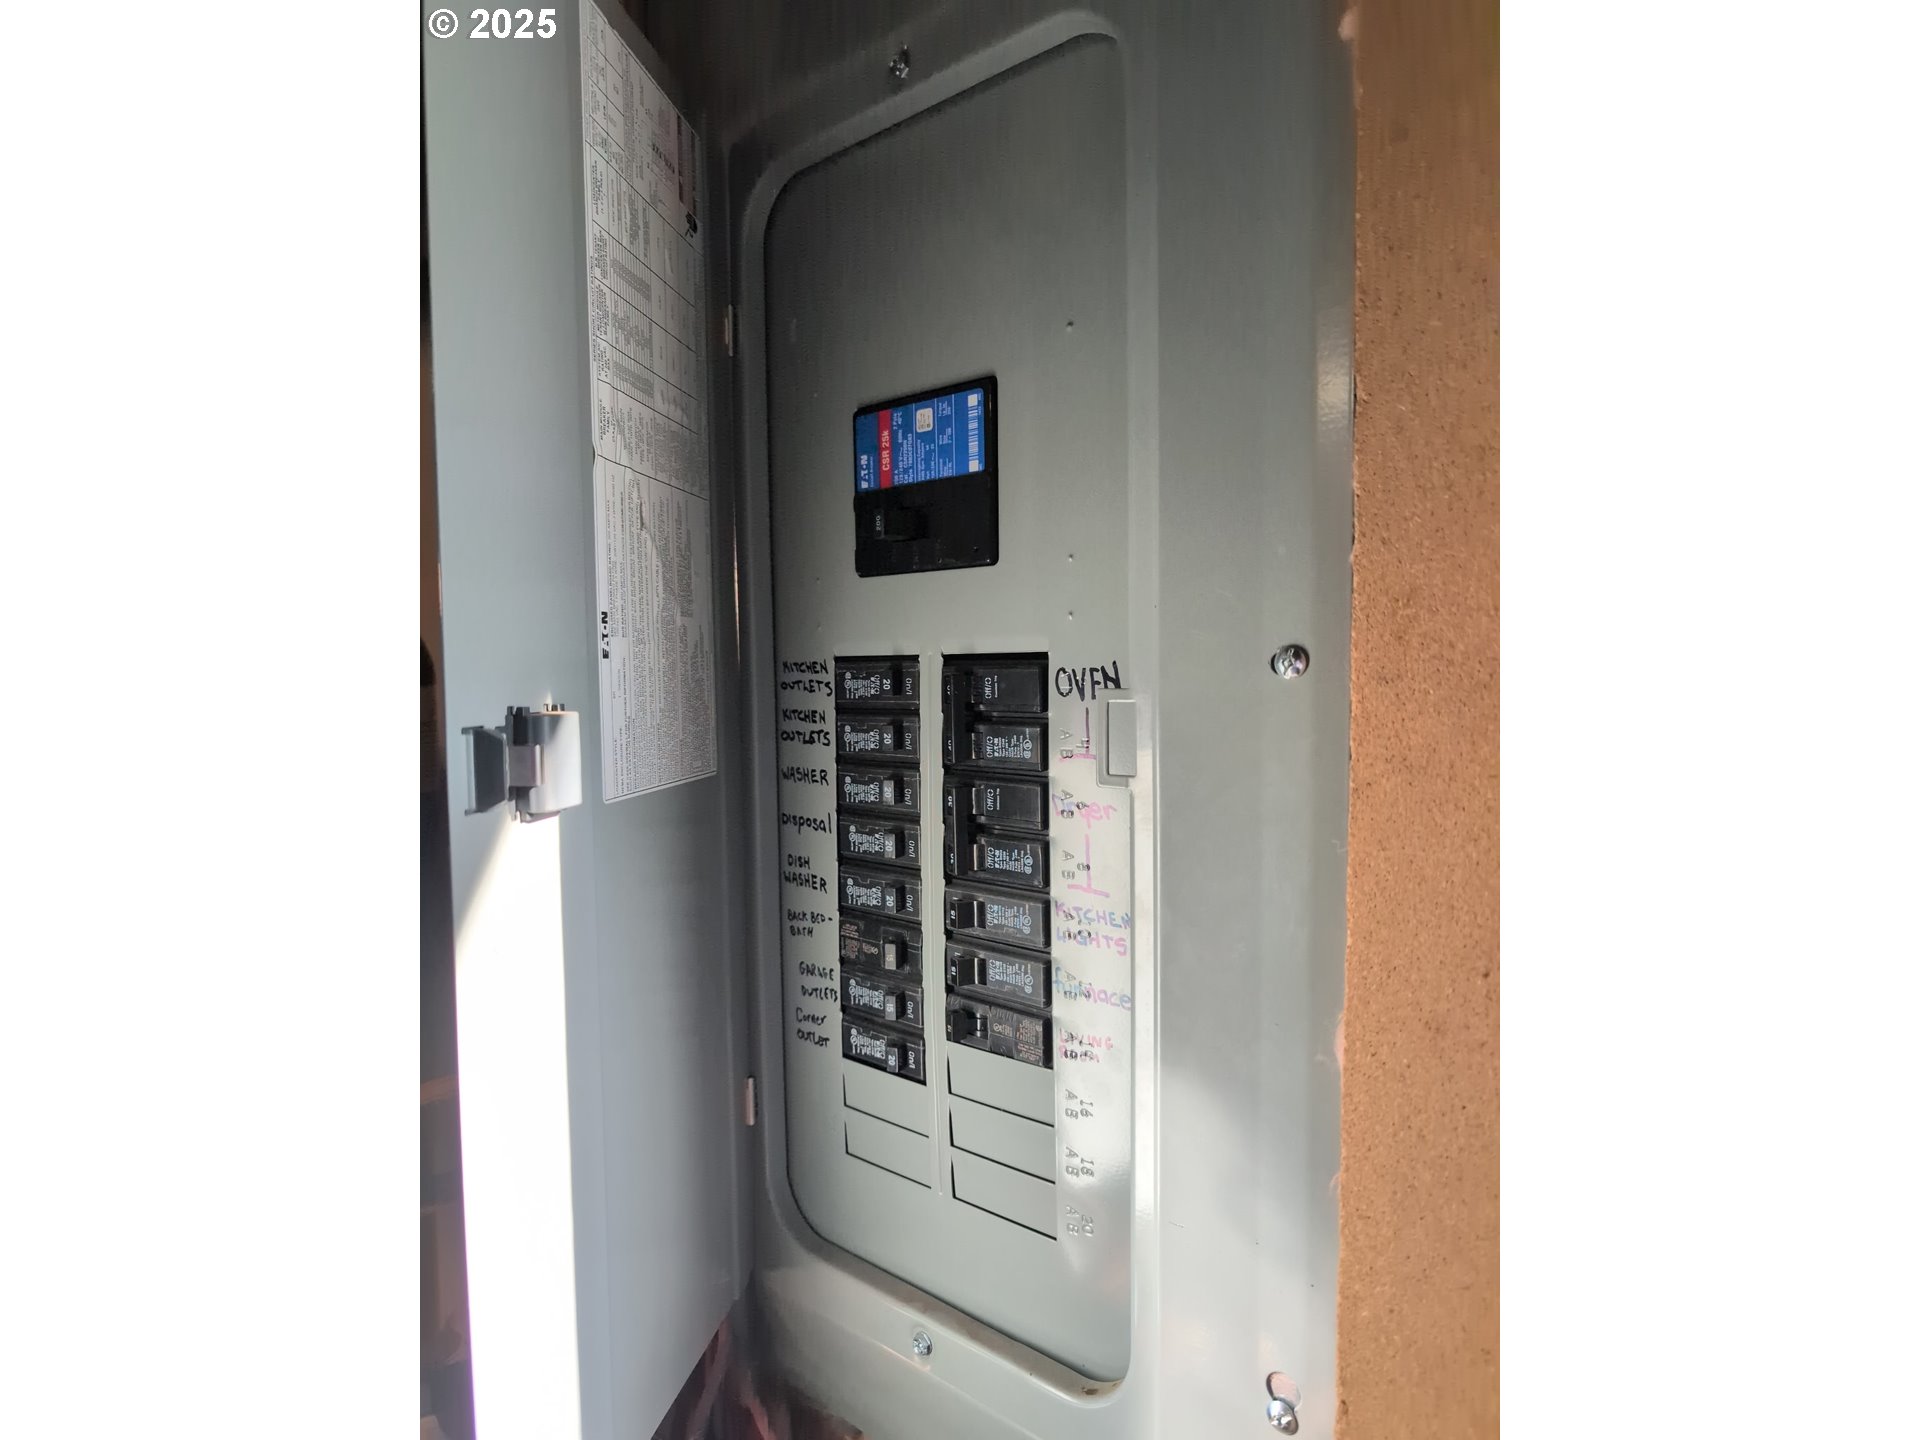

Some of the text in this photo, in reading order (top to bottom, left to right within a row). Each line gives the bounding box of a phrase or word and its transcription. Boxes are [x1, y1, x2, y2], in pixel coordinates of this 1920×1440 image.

[882, 451, 890, 471] CSR
[782, 658, 828, 674] KITCHEN
[780, 680, 833, 696] OUTLETS
[883, 679, 890, 690] 20
[782, 708, 826, 725] KITCHEN
[884, 733, 891, 744] 20
[1060, 728, 1074, 758] A B
[781, 766, 829, 786] WASHER
[884, 787, 891, 798] 20
[1061, 790, 1074, 800] A
[885, 841, 892, 851] 20
[1062, 850, 1075, 861] A
[783, 871, 827, 894] WASHER
[886, 896, 894, 907] 20
[787, 909, 808, 922] BACK
[951, 910, 956, 919] 15
[1054, 900, 1131, 930] KITCHEN
[790, 925, 814, 938] BATH
[1056, 926, 1127, 956] LIGHTS
[800, 960, 834, 981] GARAGE
[952, 966, 956, 976] 15
[801, 984, 838, 1003] OUTLETS
[886, 1003, 893, 1012] 15
[796, 1006, 827, 1026] Corner
[888, 1054, 895, 1065] 20
[1065, 1088, 1078, 1120] A B
[1080, 1099, 1094, 1118] 16
[1066, 1146, 1079, 1178] A B
[1080, 1158, 1094, 1177] 18
[1066, 1206, 1079, 1236] A B
